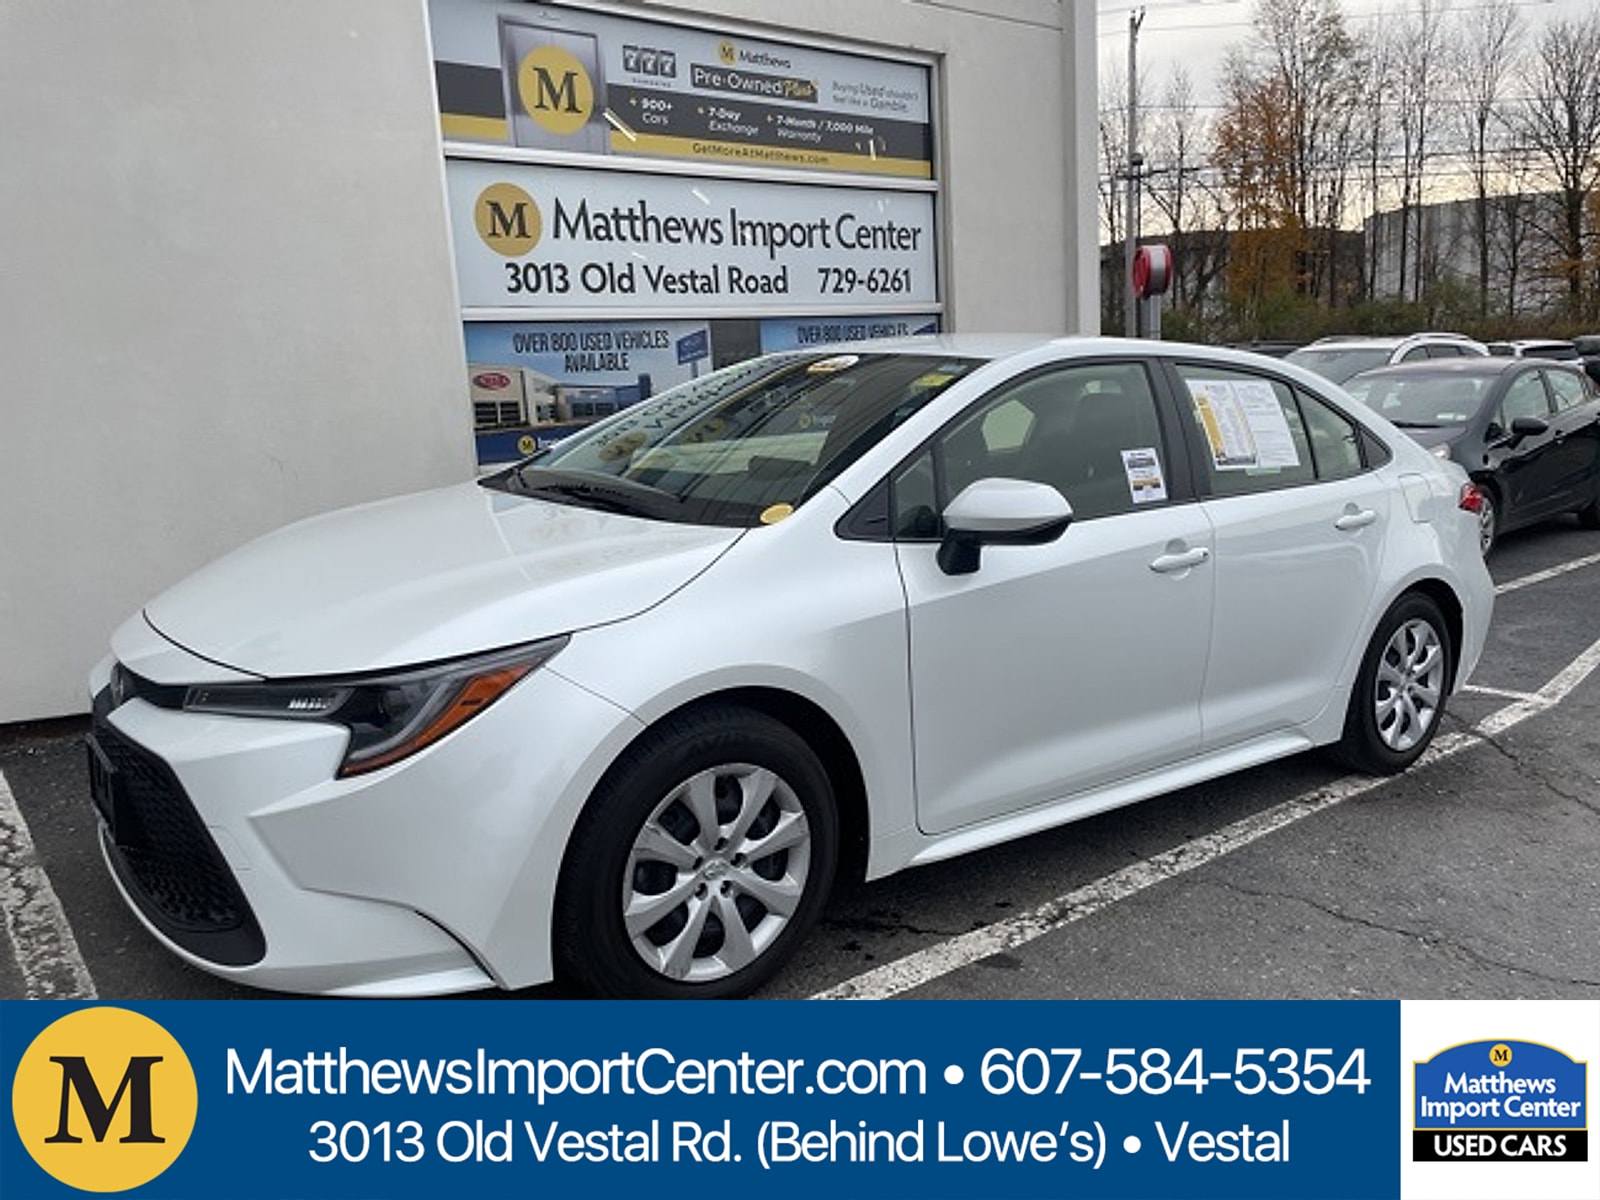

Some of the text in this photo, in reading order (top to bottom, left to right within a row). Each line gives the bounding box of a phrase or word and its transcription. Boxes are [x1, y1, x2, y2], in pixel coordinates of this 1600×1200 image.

[740, 49, 792, 69] Matthews
[533, 66, 583, 114] M
[641, 112, 670, 126] Cars
[708, 106, 742, 122] 7-Day
[709, 119, 760, 137] Exchange
[777, 128, 822, 144] Warranty
[854, 124, 874, 136] Mile
[486, 197, 922, 260] M Matthews Import Center
[505, 261, 912, 295] 3013 Old Vestal Road 729-6261
[513, 332, 549, 354] OVER
[551, 331, 578, 352] 800
[580, 331, 612, 352] USED
[613, 329, 669, 350] VEHICLES
[797, 324, 822, 344] OVER
[844, 324, 866, 341] USED
[564, 352, 630, 373] AVAILABLE
